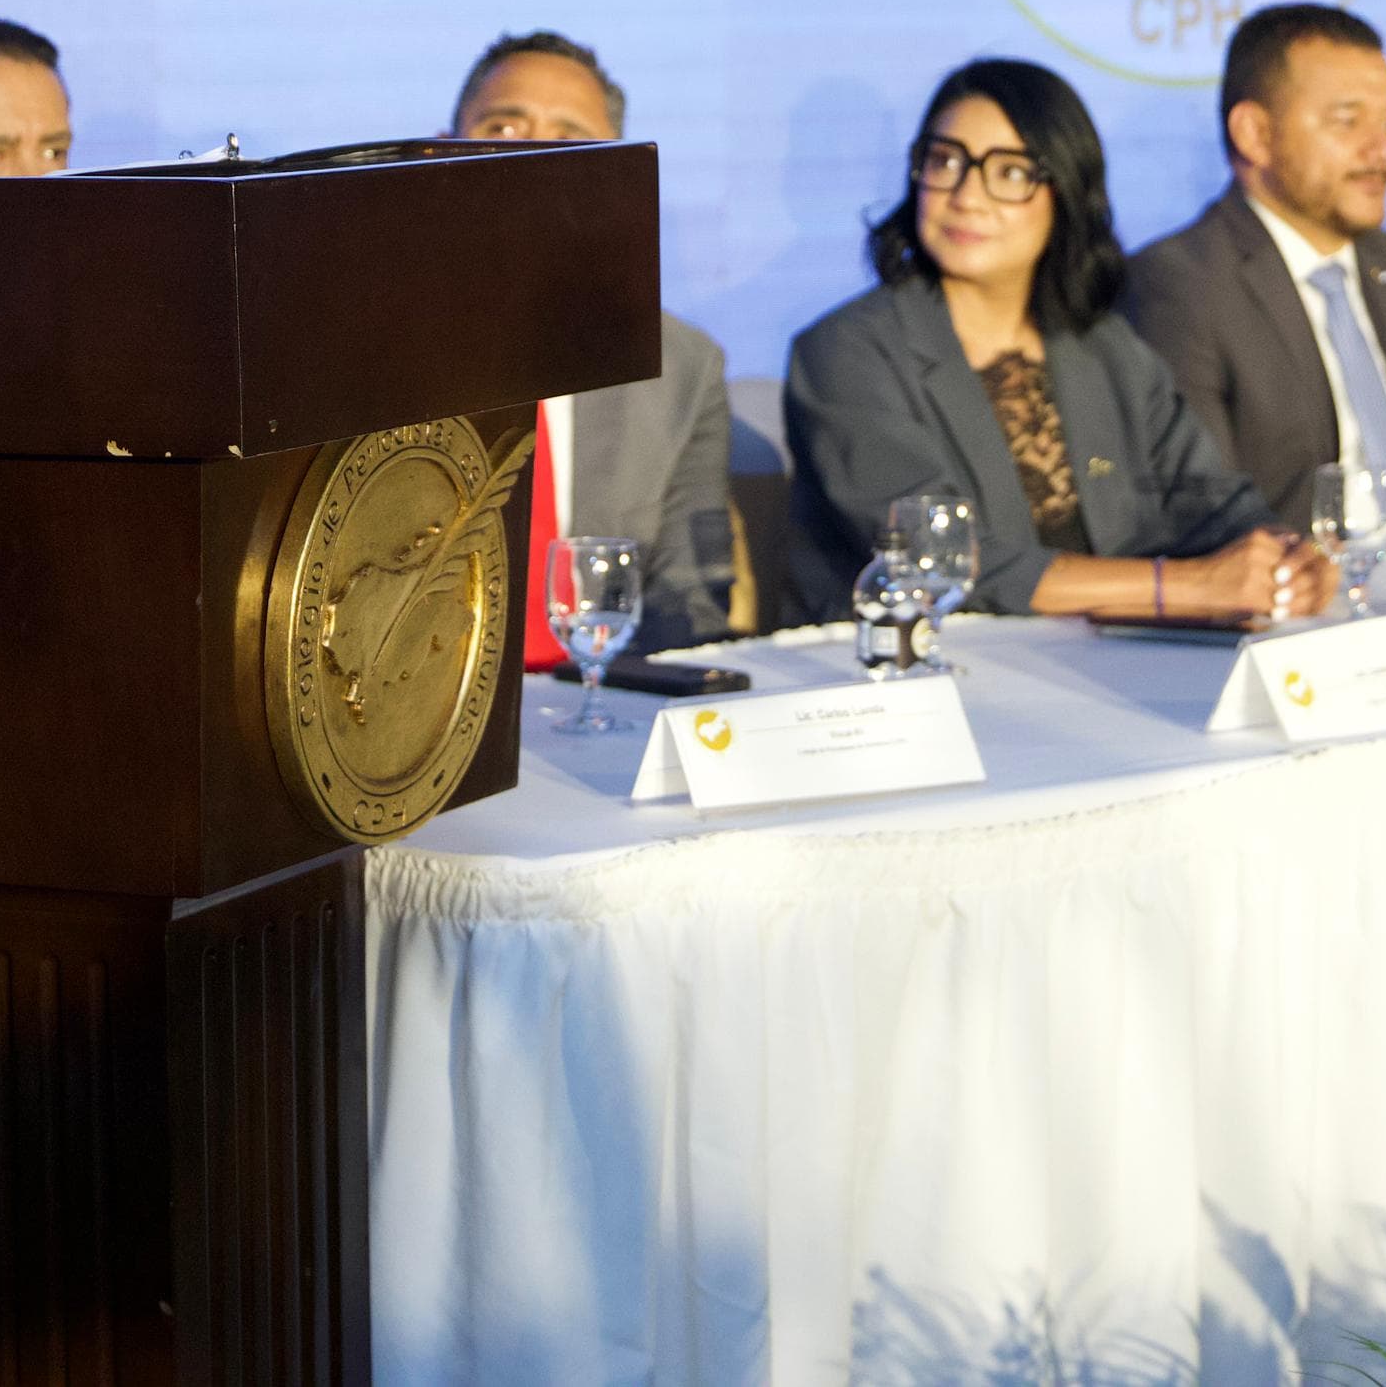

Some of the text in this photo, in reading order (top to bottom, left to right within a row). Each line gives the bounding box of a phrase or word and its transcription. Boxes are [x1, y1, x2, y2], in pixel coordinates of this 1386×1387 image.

[299, 421, 502, 738] Colegio de Periodistas de Honduras
